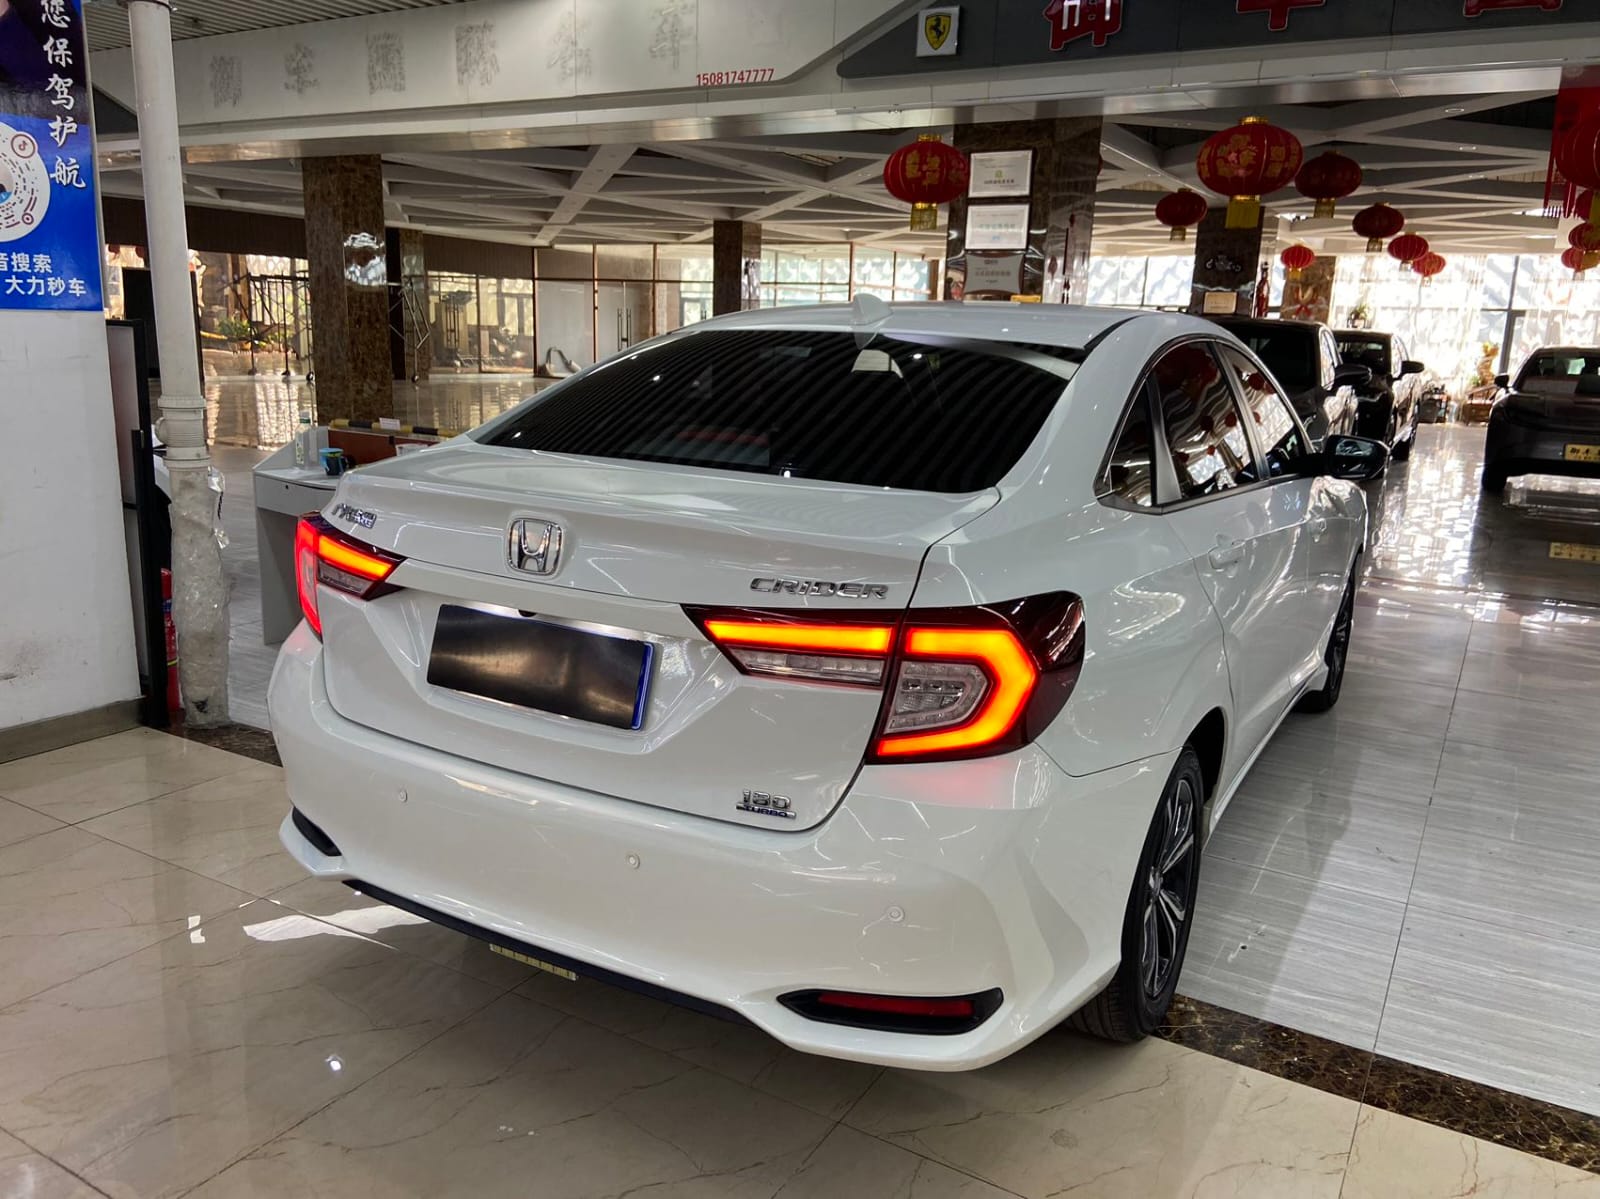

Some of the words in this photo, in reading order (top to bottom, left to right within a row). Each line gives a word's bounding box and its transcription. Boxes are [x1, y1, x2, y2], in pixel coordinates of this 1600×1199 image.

[696, 68, 775, 87] 15081747777
[41, 0, 86, 188] 您保驾护航
[5, 275, 87, 297] 大力秒车
[750, 577, 889, 600] CRIDER
[743, 789, 792, 810] 180
[741, 803, 791, 818] TURBO
